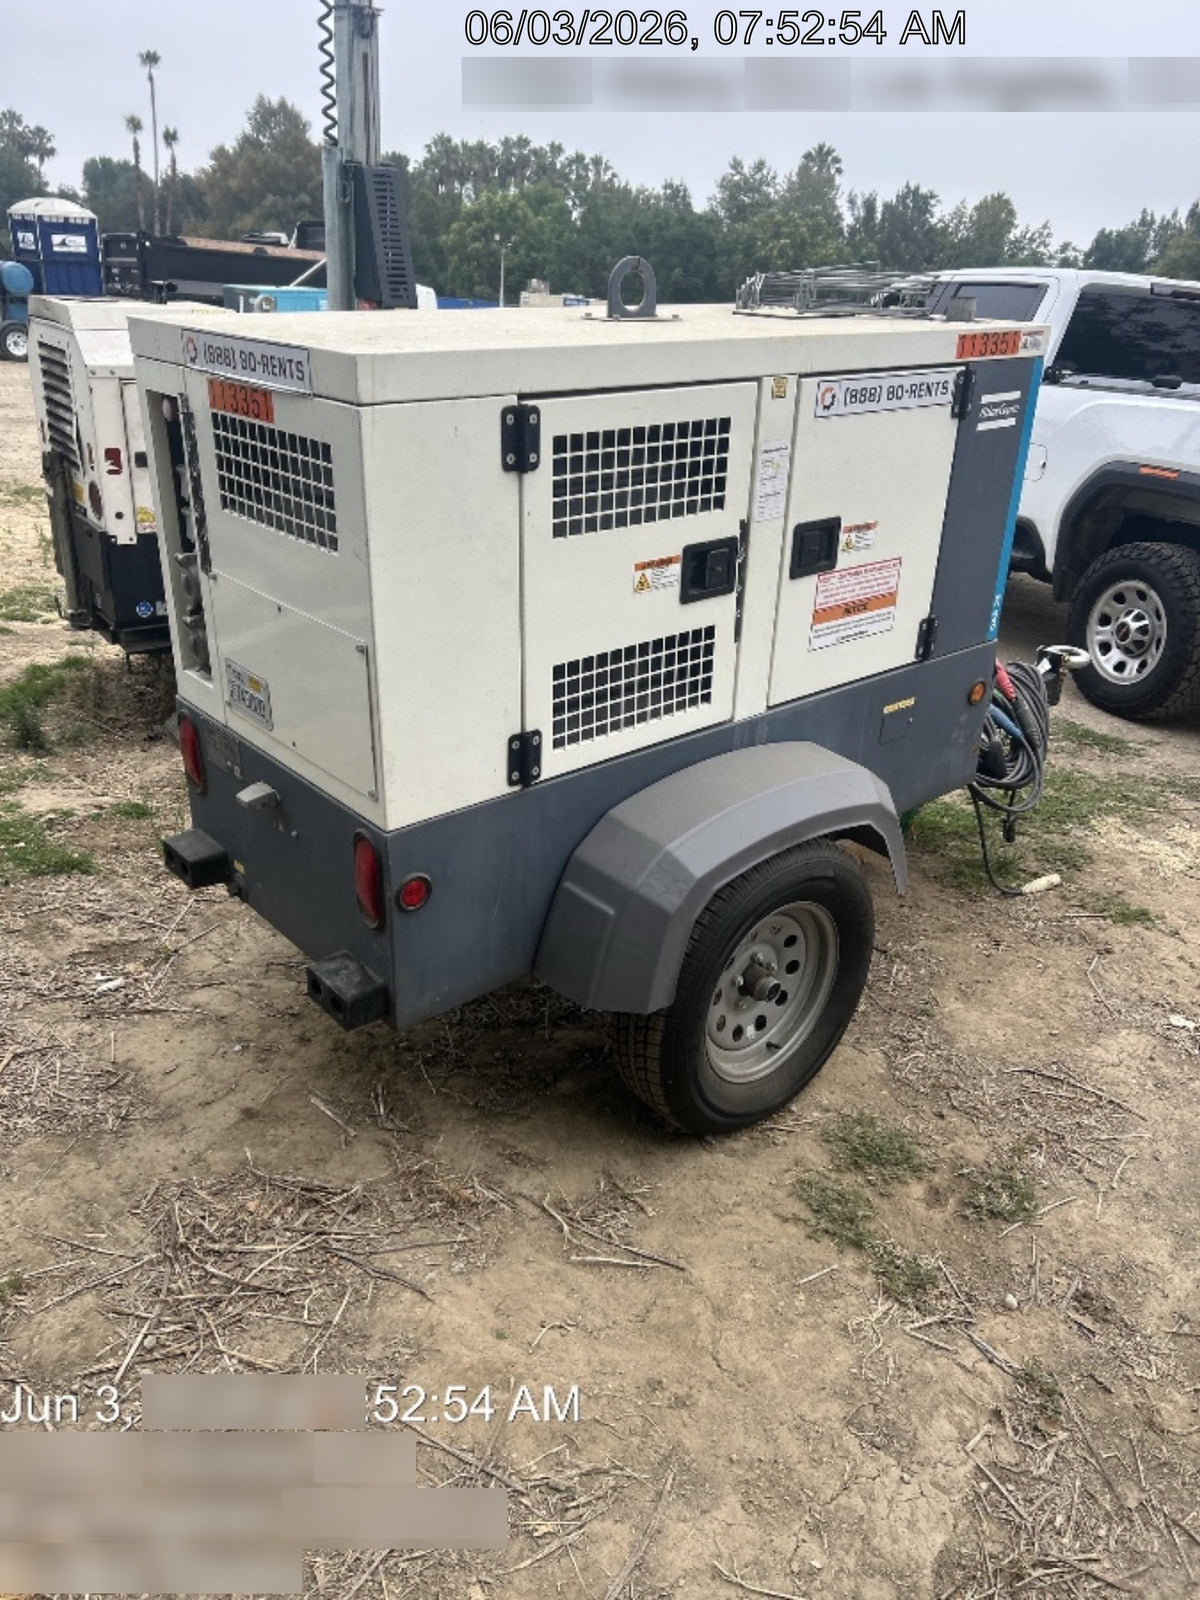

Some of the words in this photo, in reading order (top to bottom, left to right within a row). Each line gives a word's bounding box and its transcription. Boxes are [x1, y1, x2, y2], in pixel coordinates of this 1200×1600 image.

[203, 342, 236, 369] (888)
[957, 331, 1020, 358] 113351
[208, 379, 271, 421] 113351
[844, 385, 883, 407] (888)
